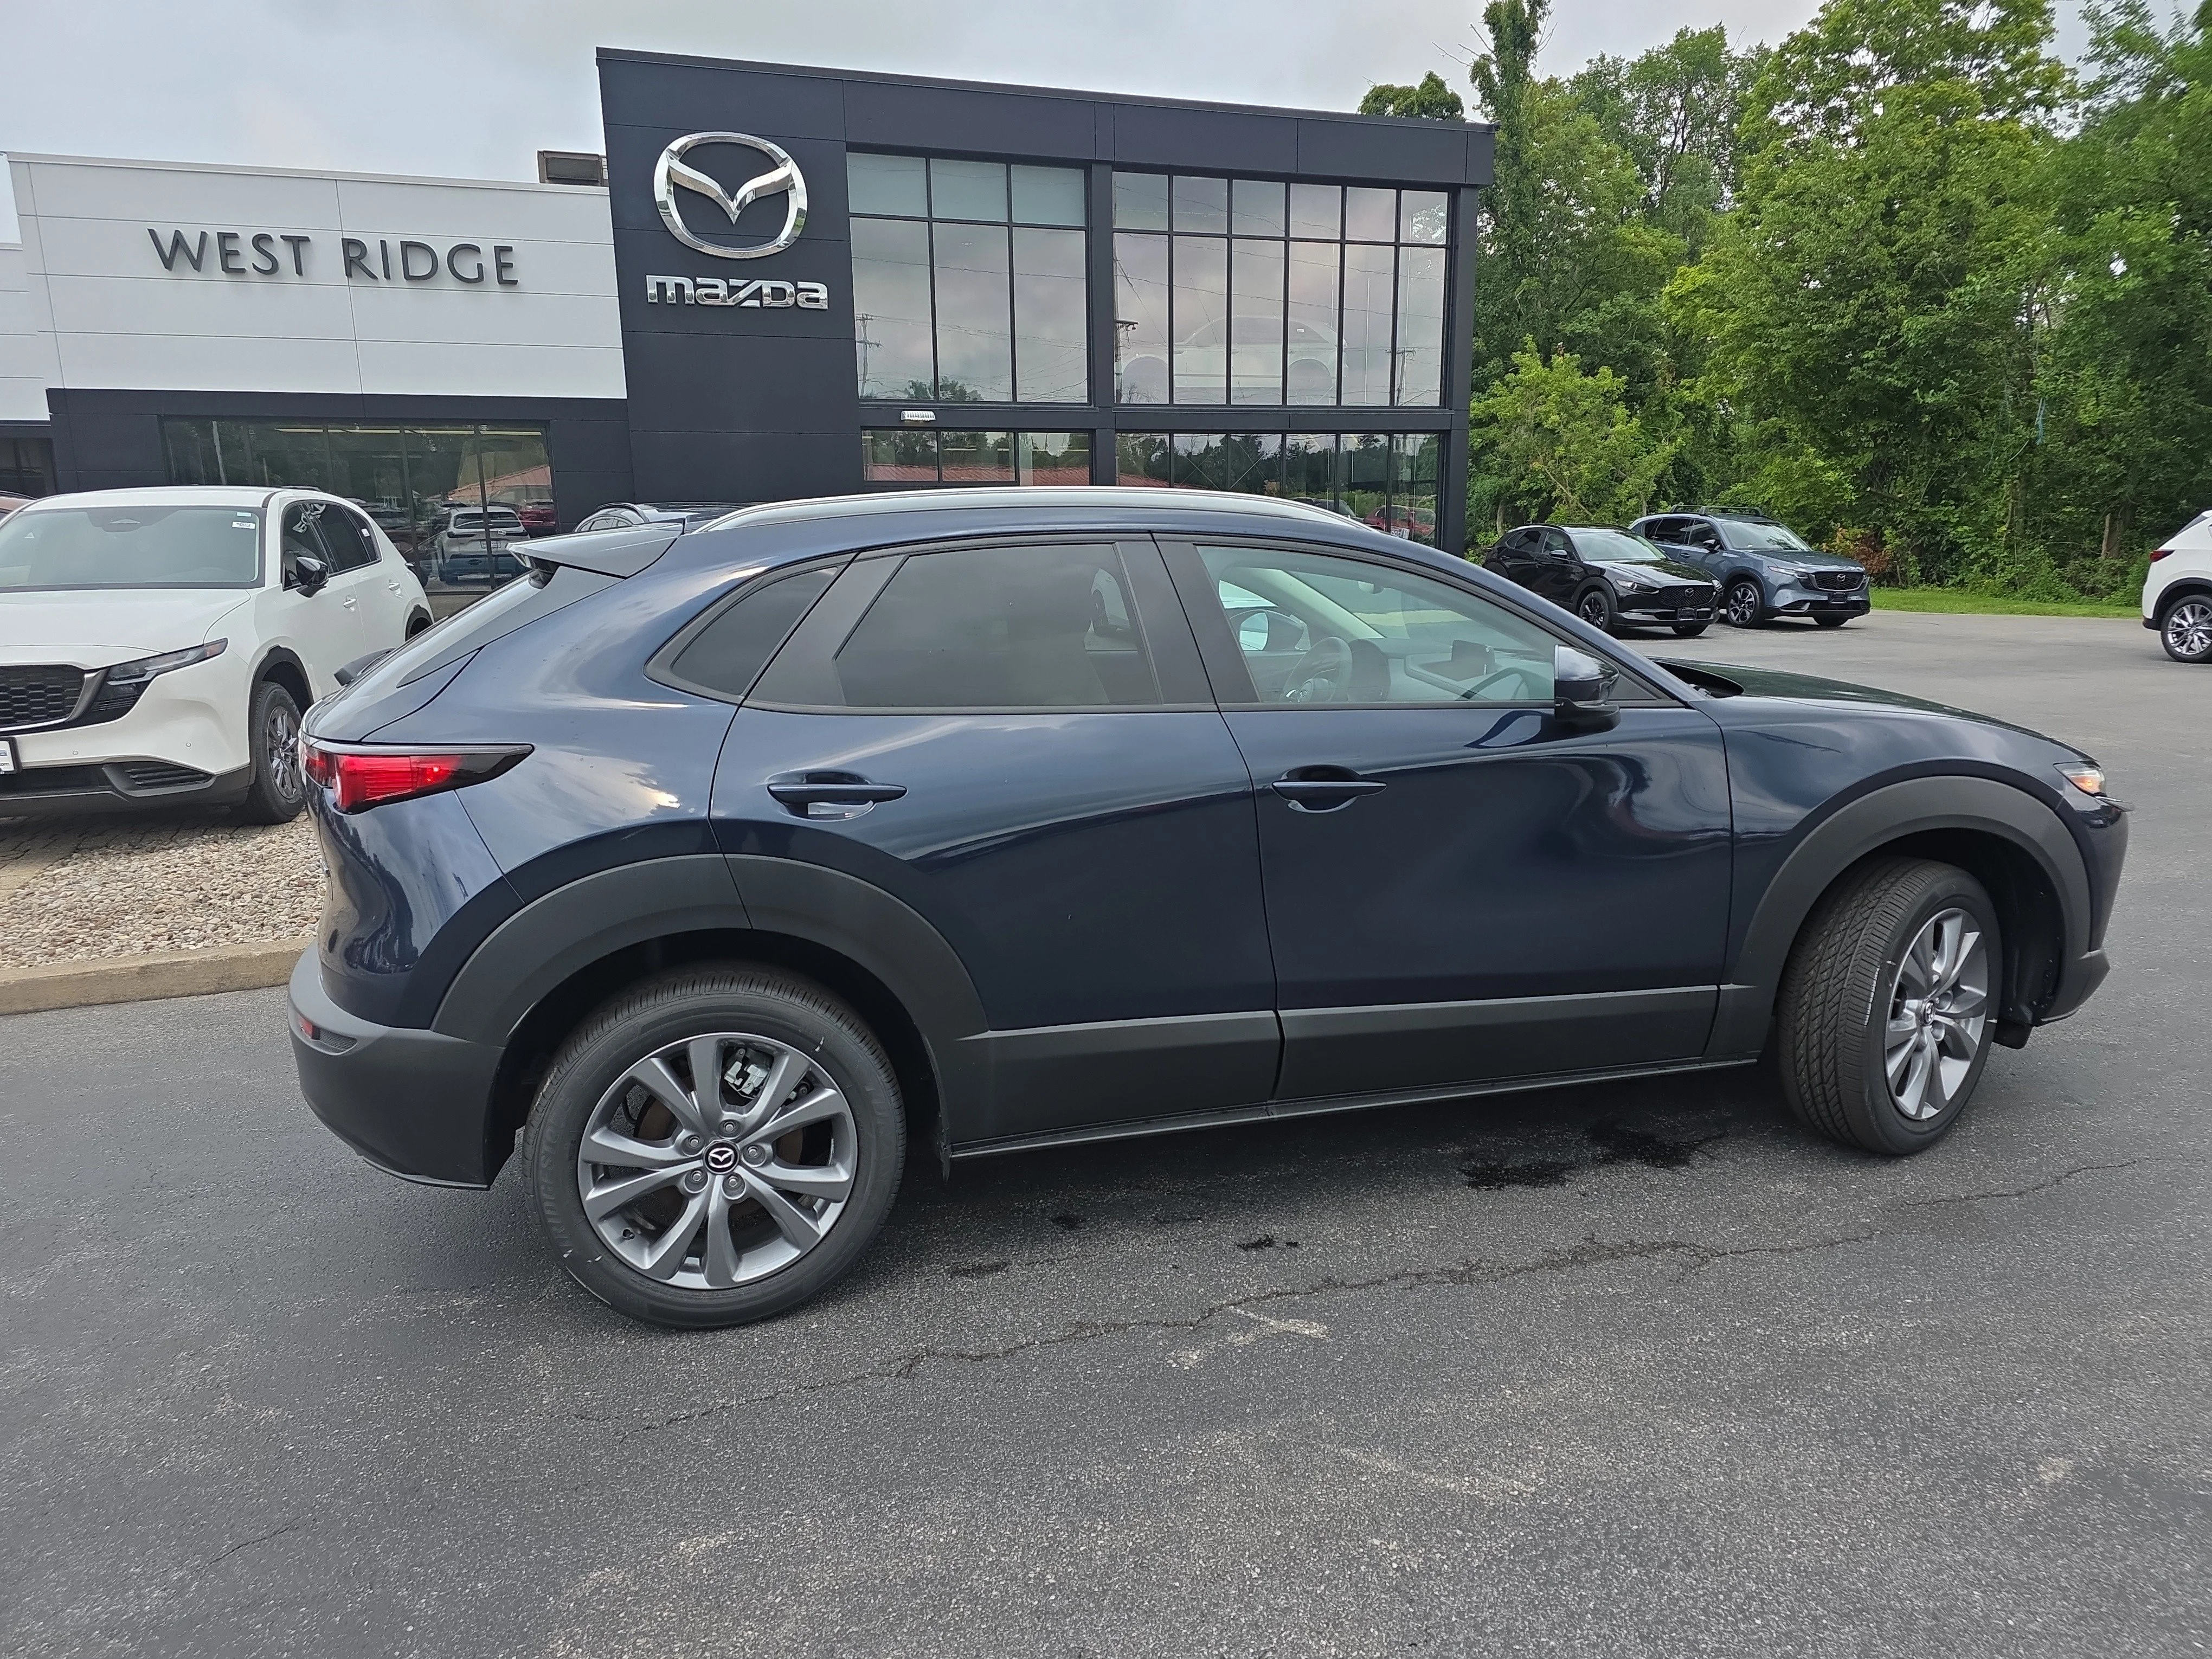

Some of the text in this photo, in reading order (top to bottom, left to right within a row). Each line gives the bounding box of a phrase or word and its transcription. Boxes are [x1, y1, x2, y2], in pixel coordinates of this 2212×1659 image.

[147, 228, 519, 285] WEST RIDGE
[646, 274, 829, 310] mazda
